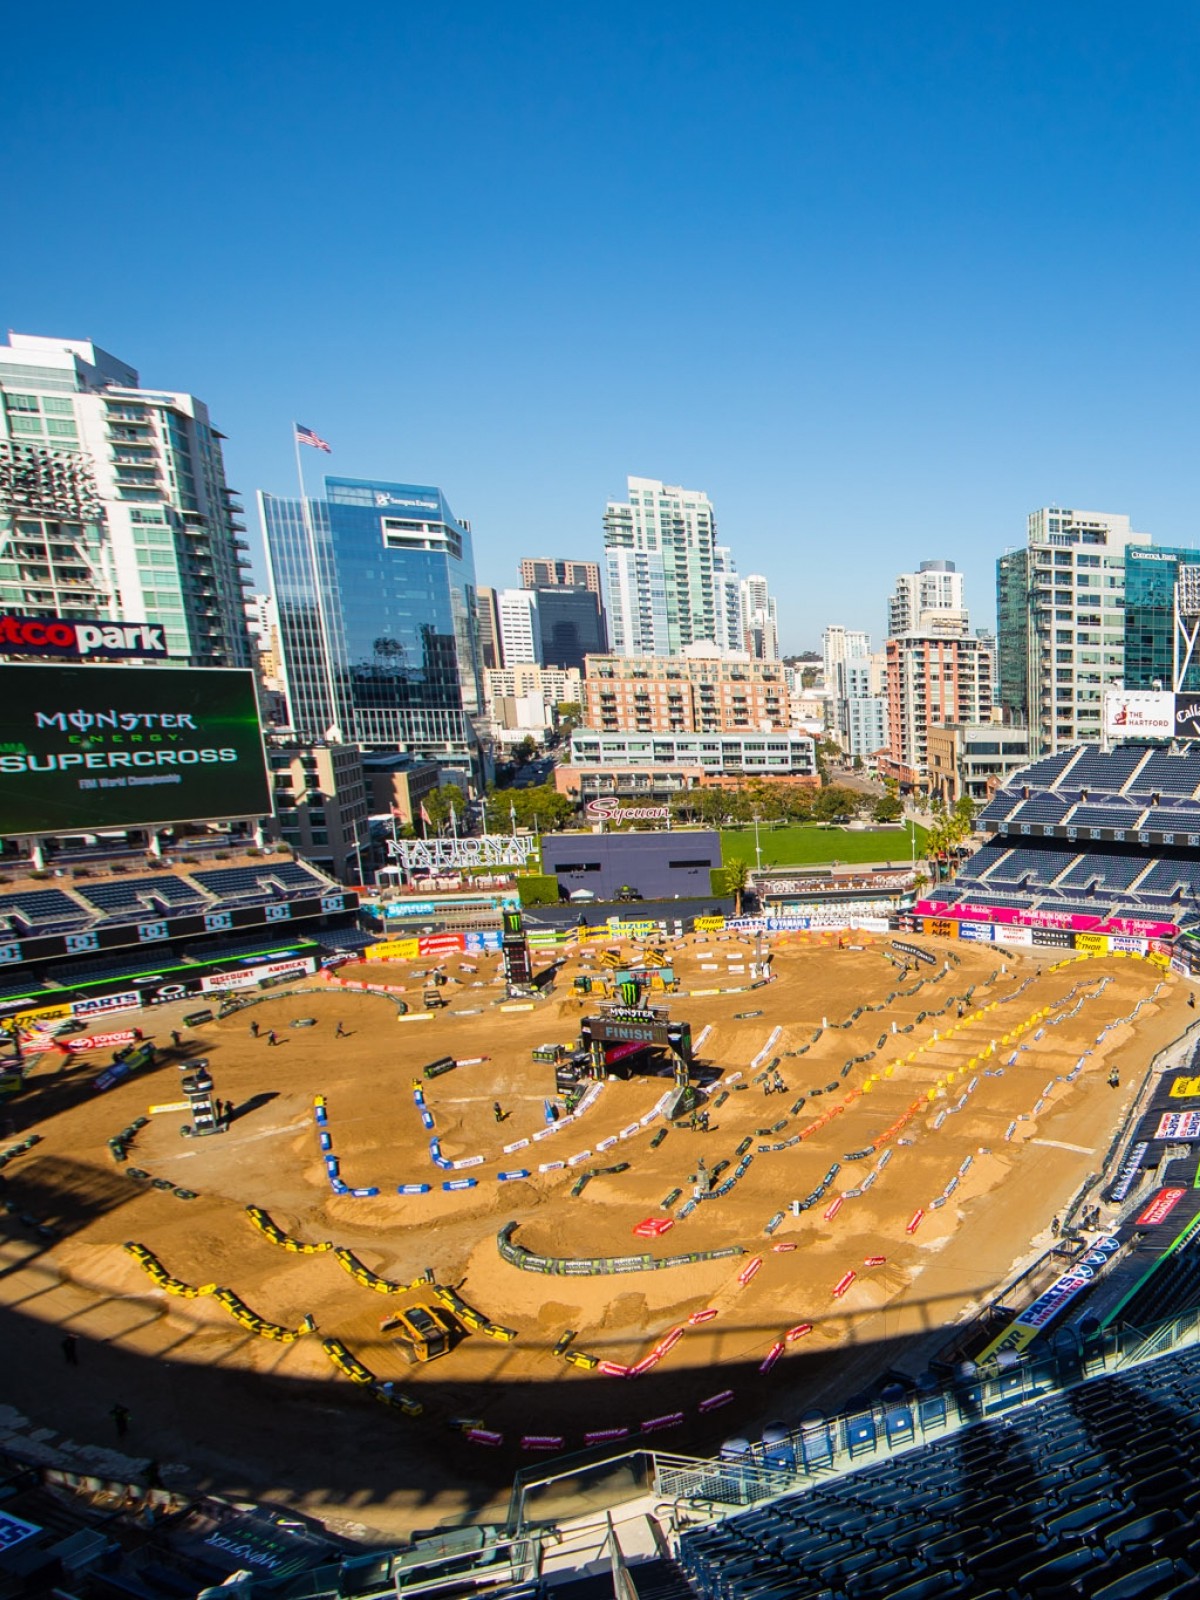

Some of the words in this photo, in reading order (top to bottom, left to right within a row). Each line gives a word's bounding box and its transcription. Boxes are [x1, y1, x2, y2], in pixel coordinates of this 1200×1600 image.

[0, 616, 75, 647] tco
[75, 624, 165, 654] park
[35, 709, 198, 732] MONSTER
[1129, 711, 1143, 719] THE
[1129, 719, 1169, 727] HARTFORD
[68, 733, 183, 744] ENERGY
[0, 748, 238, 773] SUPERCROSS
[587, 797, 672, 826] Sycuan
[387, 837, 539, 857] NATIONAL
[610, 923, 655, 931] SUZUKI
[321, 952, 358, 963] GoPro
[209, 970, 254, 985] DISCOUNT
[73, 993, 137, 1013] PARTS
[610, 1007, 654, 1017] MONSTER
[92, 1031, 134, 1042] TOYOTA
[605, 1027, 653, 1041] FINISH
[1018, 1276, 1075, 1324] PARTS
[1032, 1279, 1085, 1327] UNLIMITED
